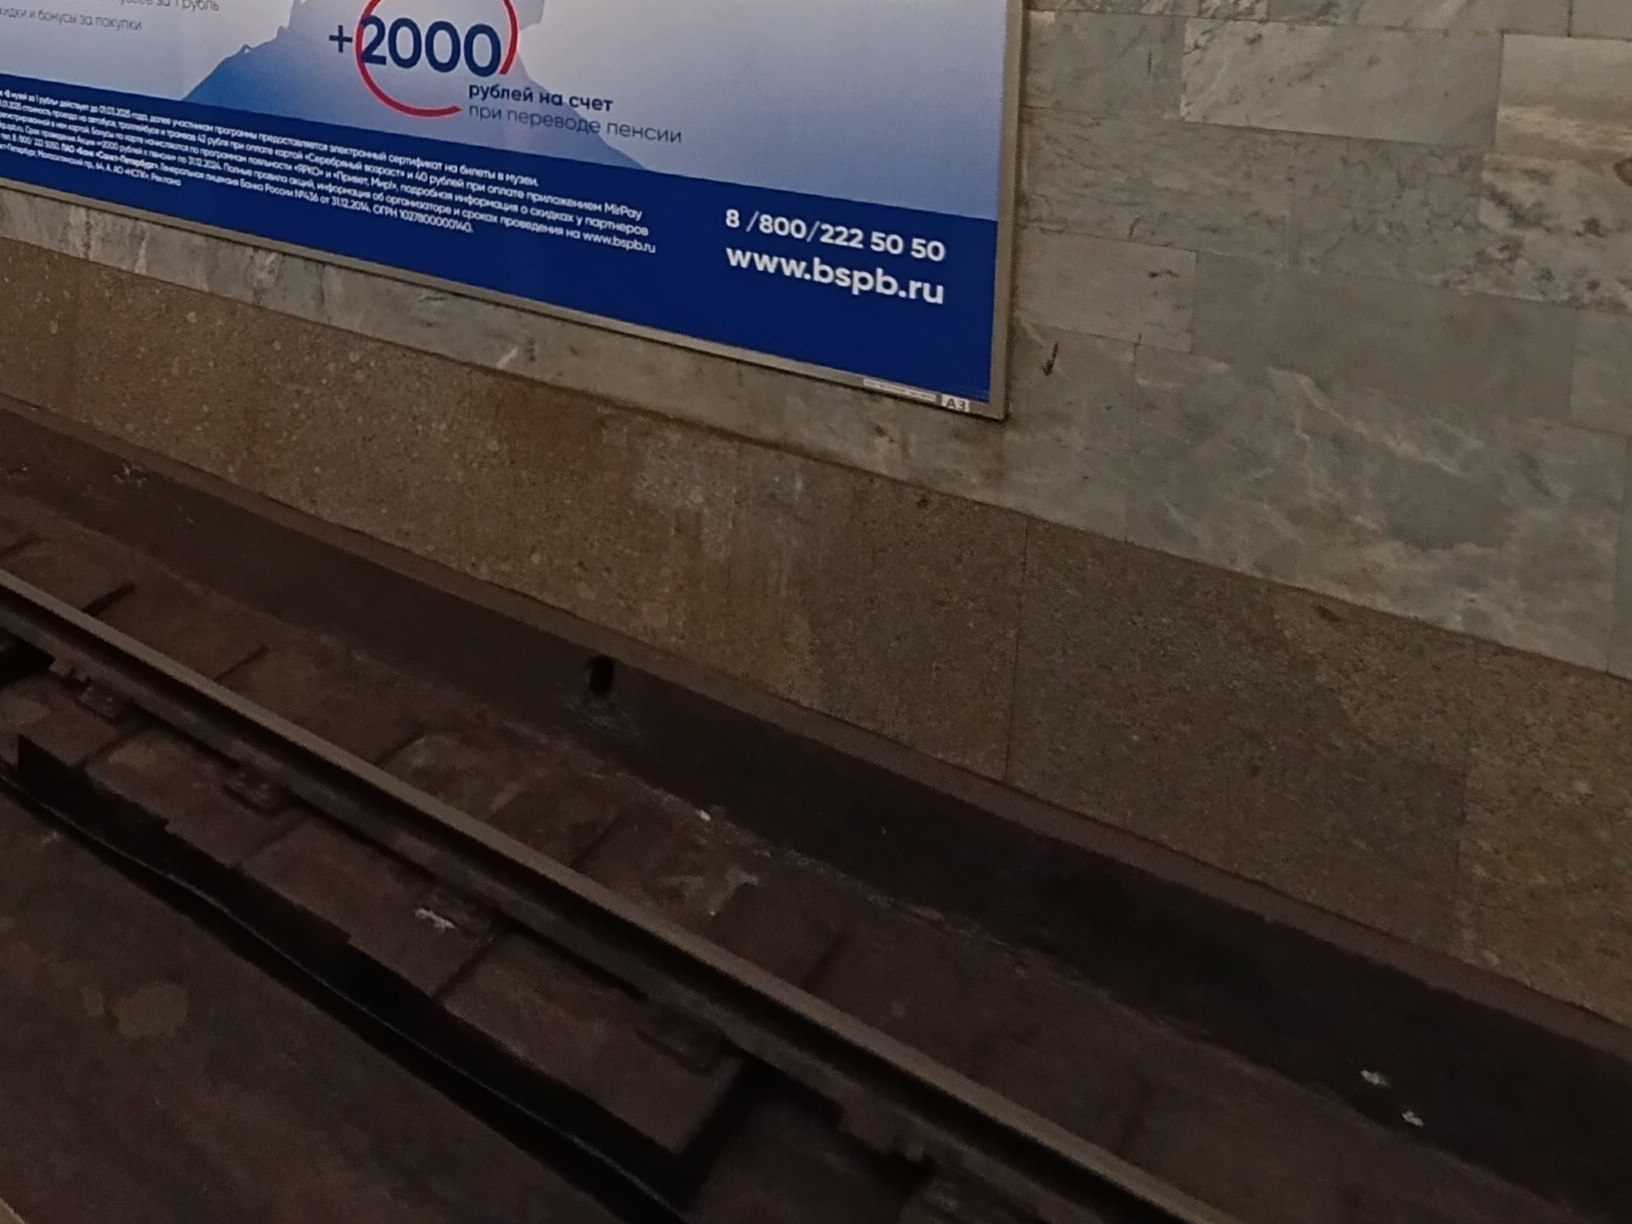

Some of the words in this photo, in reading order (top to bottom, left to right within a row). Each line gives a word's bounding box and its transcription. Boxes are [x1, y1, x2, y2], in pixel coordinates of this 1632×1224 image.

[29, 10, 36, 19] и
[38, 9, 77, 25] бонусы
[79, 14, 93, 25] за
[95, 16, 142, 31] покупки
[328, 14, 503, 78] +2000
[469, 83, 533, 103] рублей
[538, 91, 563, 106] на
[568, 94, 614, 113] счет
[469, 104, 503, 122] при
[507, 109, 601, 135] переводе
[606, 121, 682, 144] пенсии
[387, 153, 442, 173] сертификат
[444, 164, 457, 174] на
[459, 165, 495, 180] билеты
[372, 202, 397, 216] ОГРН
[399, 182, 453, 203] подробная
[454, 192, 518, 215] информация
[530, 208, 573, 225] скидках
[584, 218, 648, 239] партнеров
[414, 170, 427, 182] 40
[429, 173, 463, 190] рублей
[465, 181, 485, 194] при
[487, 185, 524, 199] оплате
[526, 192, 601, 215] приложением
[604, 204, 642, 222] MirPay
[371, 190, 384, 201] об
[385, 194, 451, 216] организаторе
[461, 209, 497, 225] сроках
[499, 216, 564, 237] проведения
[565, 228, 580, 239] на
[582, 229, 655, 255] www.bspb.ru
[725, 209, 740, 227] 8
[870, 231, 904, 254] 50
[910, 238, 946, 262] 50
[725, 247, 945, 304] www.bspb.ru
